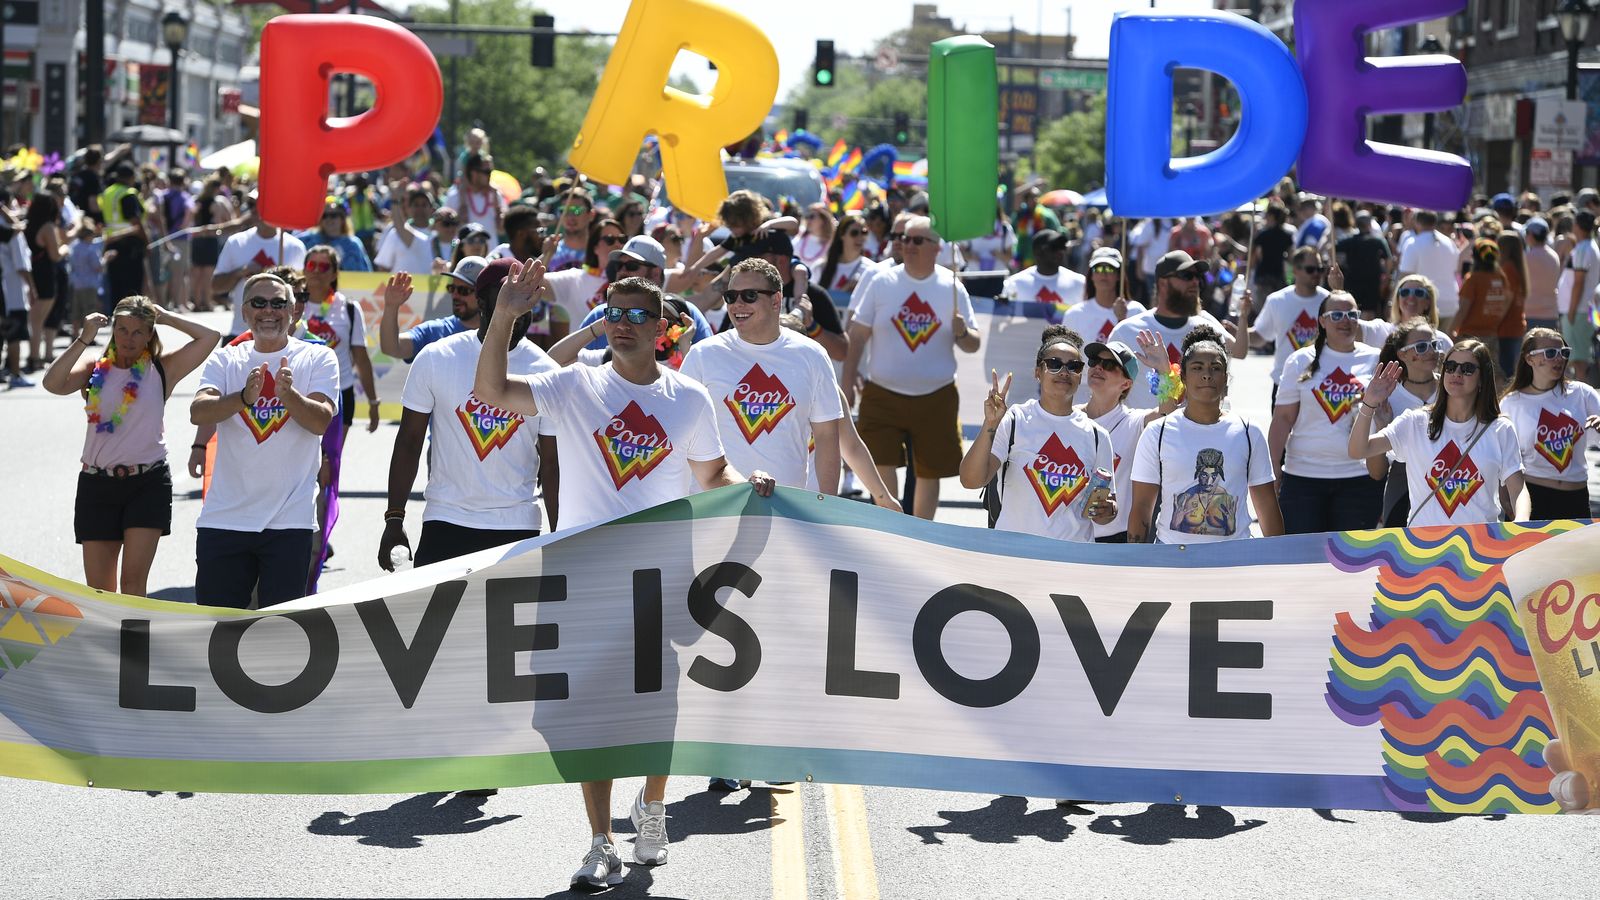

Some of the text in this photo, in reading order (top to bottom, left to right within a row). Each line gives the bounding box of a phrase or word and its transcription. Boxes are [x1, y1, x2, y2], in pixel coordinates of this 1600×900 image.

[728, 383, 795, 405] Coors
[248, 407, 287, 420] LIGHT
[739, 404, 779, 418] LIGHT
[470, 415, 509, 433] LIGHT
[598, 418, 672, 450] Coors
[608, 441, 655, 462] LIGHT
[1027, 454, 1089, 478] Coors
[1037, 472, 1078, 489] LIGHT
[119, 561, 1273, 720] LOVE IS LOVE
